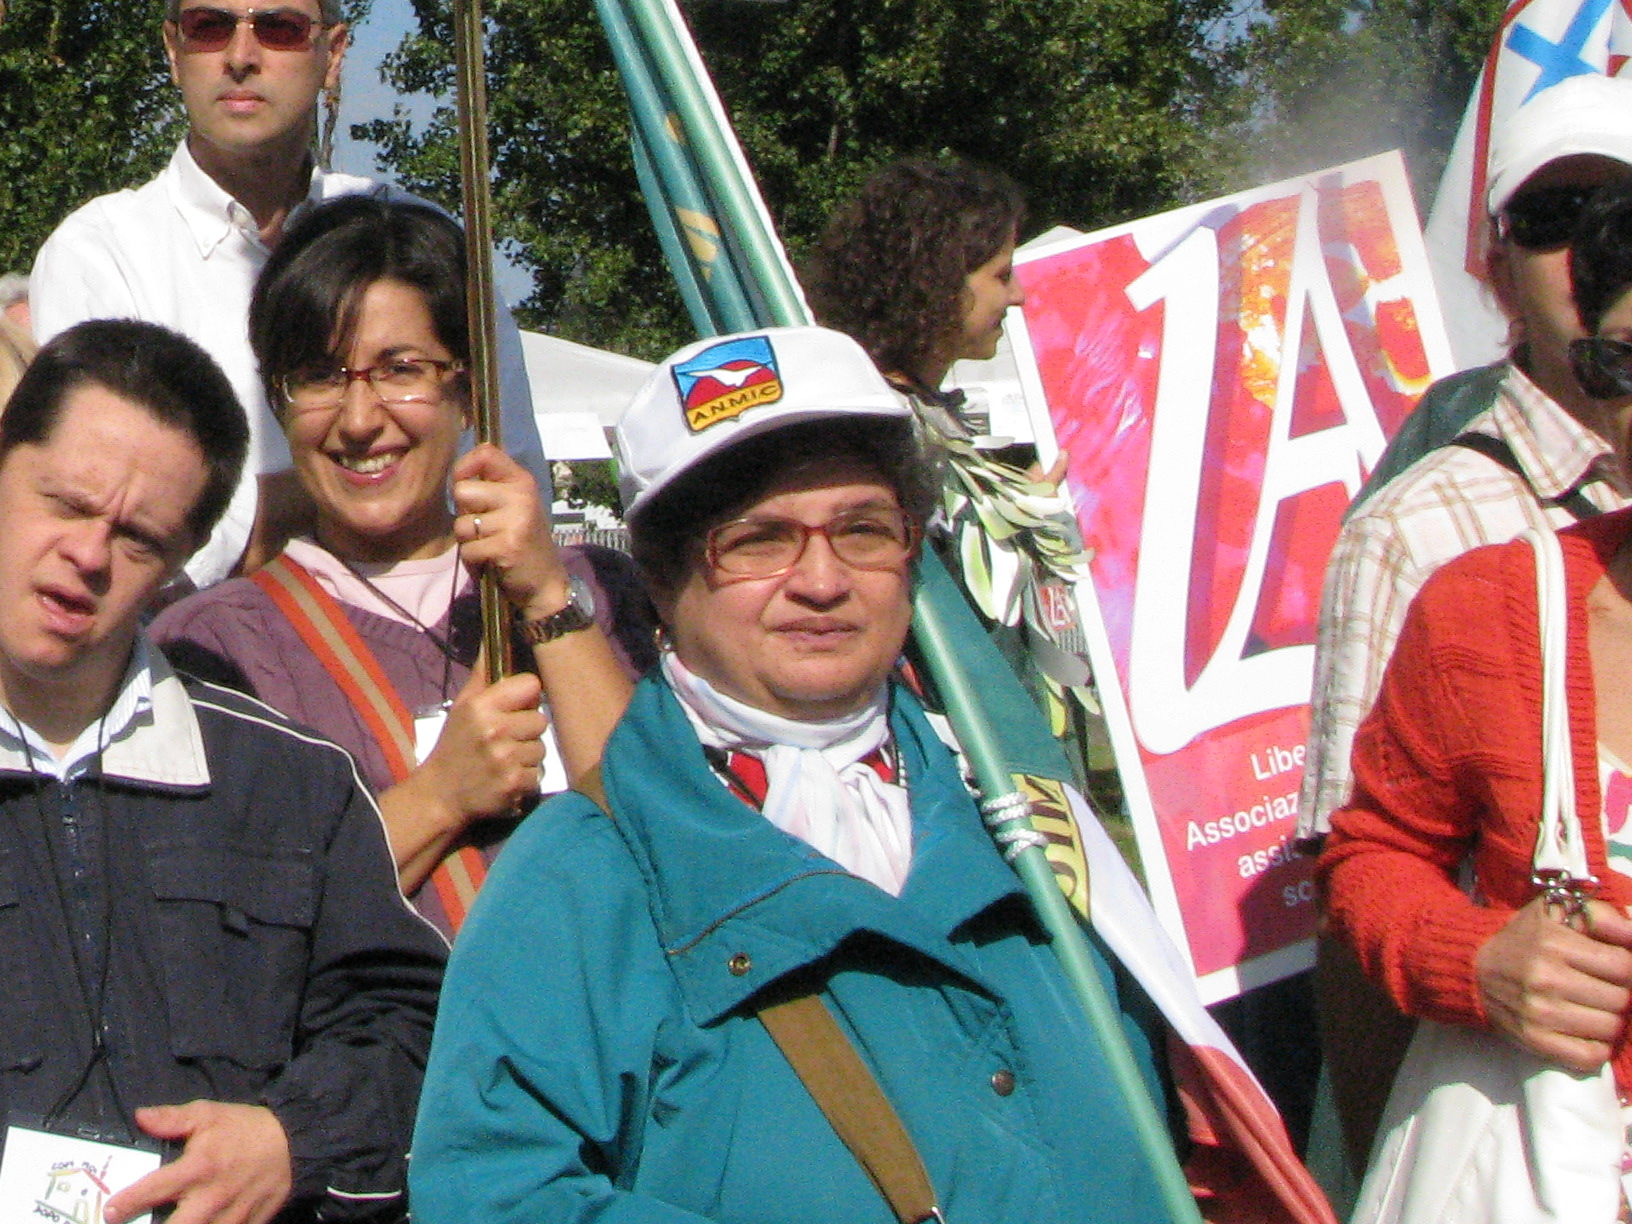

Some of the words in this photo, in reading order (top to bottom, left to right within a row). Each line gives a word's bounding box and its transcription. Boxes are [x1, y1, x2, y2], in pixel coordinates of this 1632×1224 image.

[691, 383, 781, 425] ANMIC
[1249, 742, 1306, 782] Libe
[1185, 791, 1299, 852] Associaz
